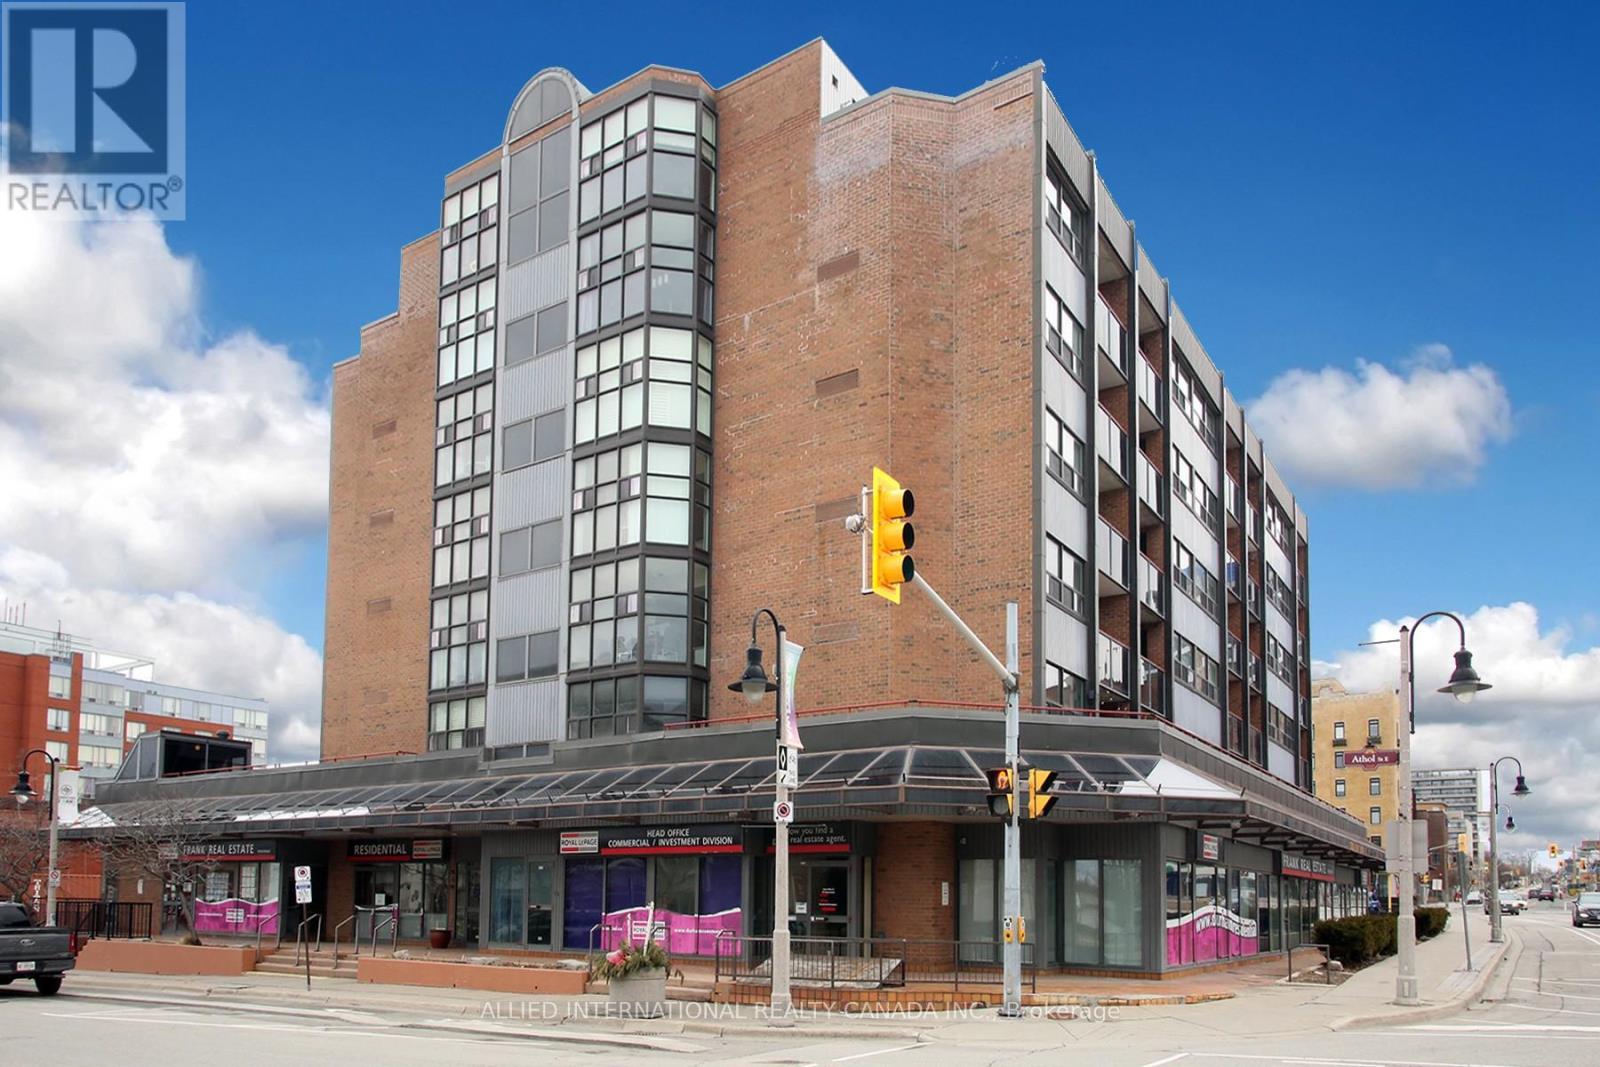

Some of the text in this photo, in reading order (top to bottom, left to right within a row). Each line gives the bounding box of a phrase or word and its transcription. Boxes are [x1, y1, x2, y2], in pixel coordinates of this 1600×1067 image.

[1352, 754, 1376, 763] Athol
[667, 828, 689, 837] OFFICE
[608, 840, 649, 848] COMMERCIAL
[658, 838, 699, 846] INVESTMENT
[702, 837, 733, 845] DIVISION
[183, 845, 205, 854] FRANK
[208, 845, 225, 854] REAL
[228, 844, 255, 854] ESTATE
[354, 844, 407, 855] RESIDENTIAL
[1282, 854, 1299, 869] FRANK
[1300, 858, 1312, 872] REAL
[1312, 860, 1328, 875] ESTATE
